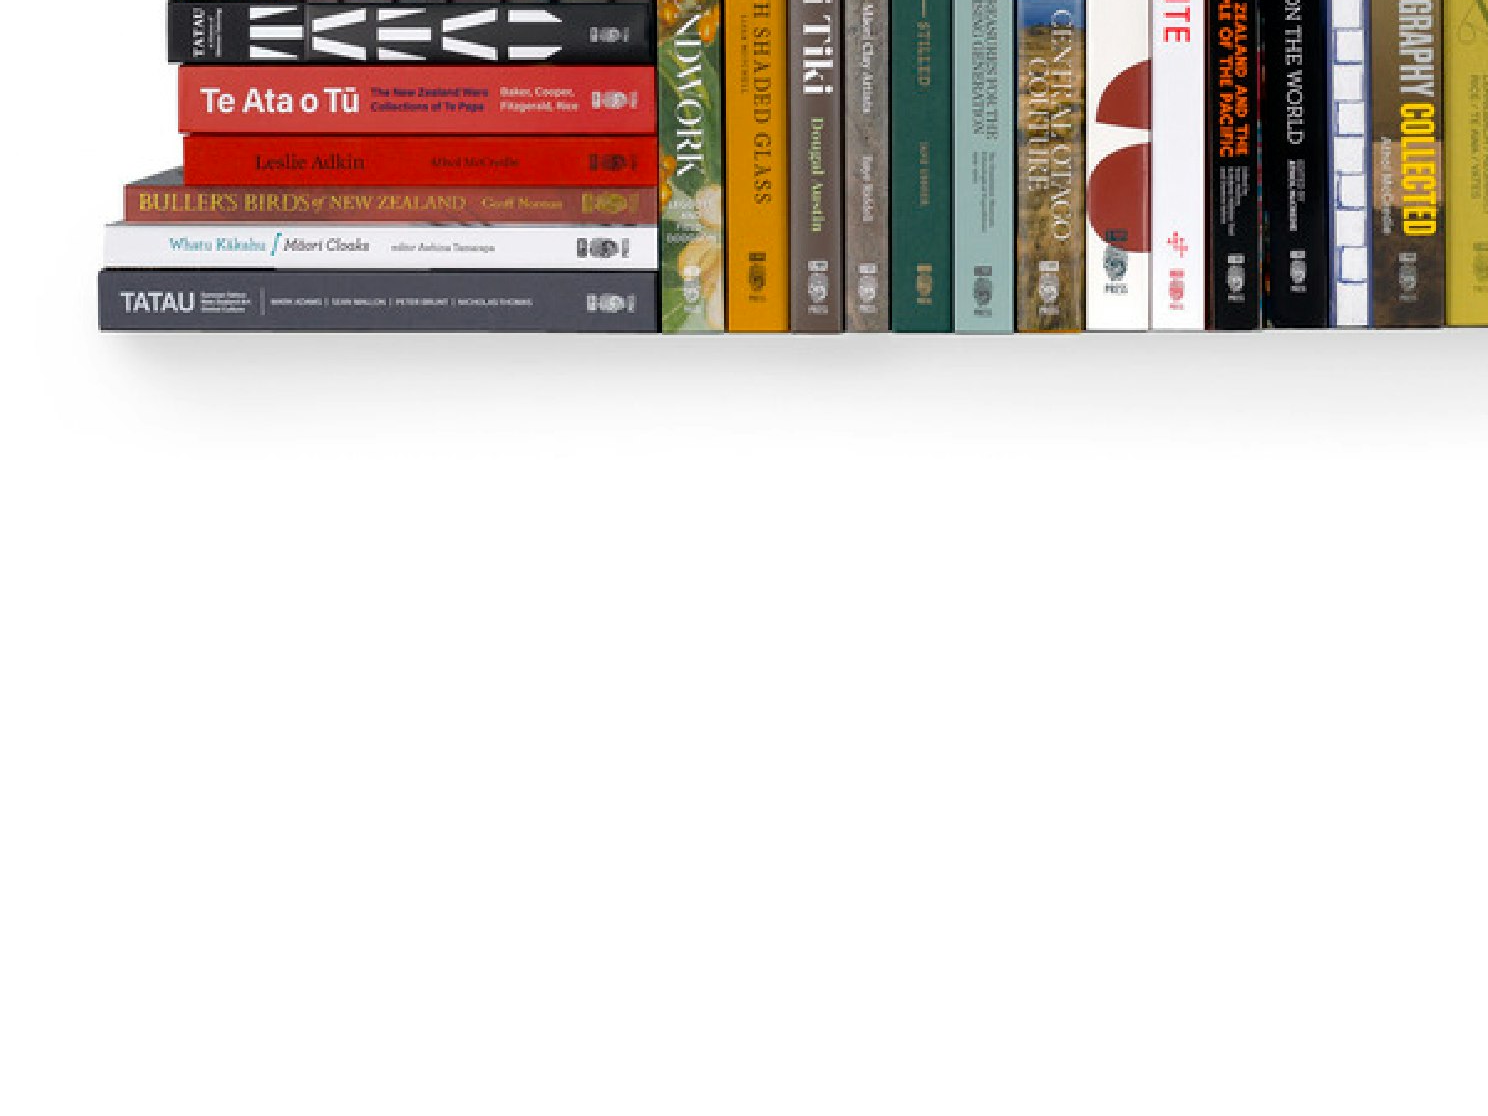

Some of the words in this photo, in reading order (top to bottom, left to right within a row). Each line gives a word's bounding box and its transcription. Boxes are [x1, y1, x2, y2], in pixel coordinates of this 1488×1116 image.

[802, 14, 833, 94] Tiki
[917, 21, 931, 86] STILLED
[1219, 27, 1232, 47] OF
[1234, 1, 1248, 78] ZEALAND
[1285, 25, 1302, 65] THE
[753, 26, 771, 124] SHADED
[972, 41, 985, 134] GENERATION
[986, 79, 998, 107] FOR
[1051, 9, 1072, 138] CENTRAL
[1219, 56, 1232, 87] THE
[200, 87, 235, 113] Te
[242, 87, 293, 113] Ata
[300, 93, 319, 113] o
[323, 87, 360, 113] Tū
[987, 109, 999, 140] THE
[1028, 57, 1050, 191] COUTURE
[1219, 93, 1233, 157] PACIFIC
[1234, 84, 1248, 118] AND
[1286, 70, 1305, 144] WORLD
[256, 154, 306, 170] Leslie
[312, 154, 364, 170] Adkin
[808, 117, 825, 175] Dougal
[1234, 124, 1250, 156] THE
[753, 131, 772, 205] GLASS
[1051, 144, 1072, 242] OTAGO
[1399, 103, 1437, 236] COLLECTED
[244, 193, 310, 212] BIRDS
[328, 195, 373, 210] NEW
[377, 195, 467, 210] ZEALAND
[810, 183, 825, 232] Austin
[326, 237, 369, 252] Cloaks
[120, 291, 195, 314] TATAU
